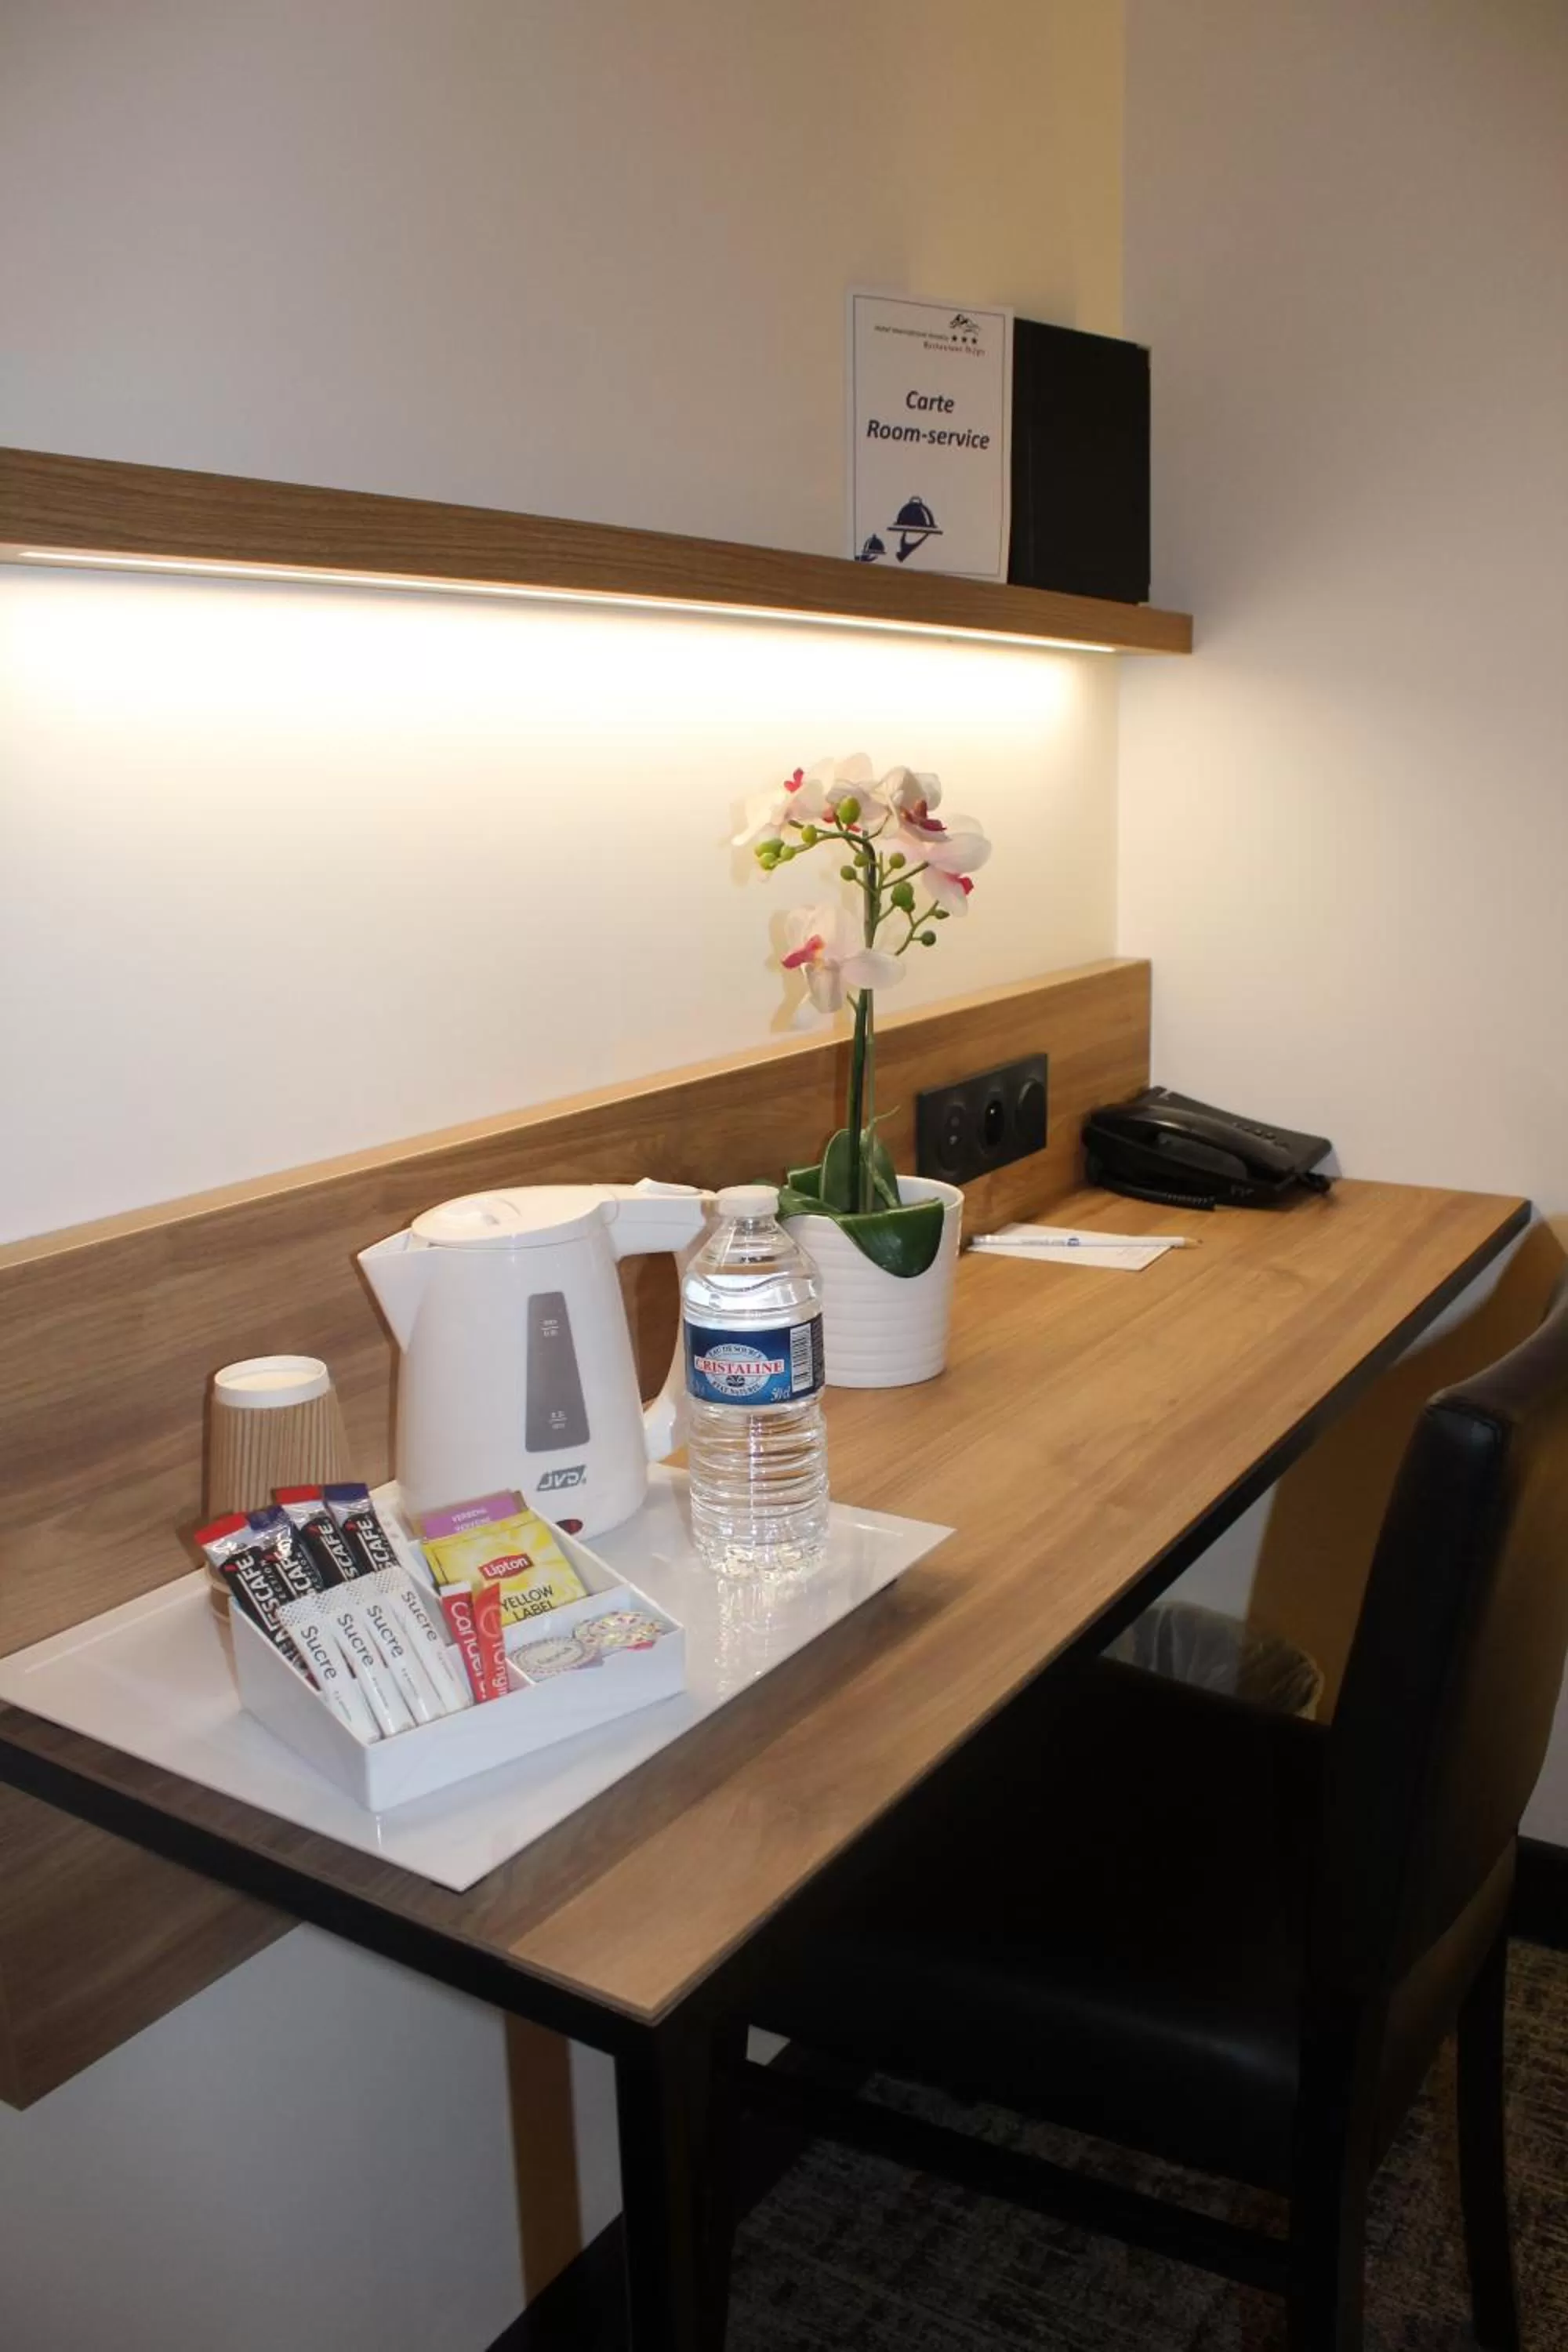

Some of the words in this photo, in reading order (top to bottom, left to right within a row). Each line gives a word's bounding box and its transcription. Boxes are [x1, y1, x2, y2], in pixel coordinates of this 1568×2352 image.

[906, 390, 955, 413] Carte
[867, 419, 990, 449] Room-service
[538, 1471, 581, 1490] JVD
[484, 1556, 528, 1577] Lipton
[502, 1584, 554, 1613] YELLOW
[512, 1602, 554, 1621] LABEL
[401, 1591, 437, 1642] Sucre
[337, 1613, 374, 1667] Sucre
[366, 1605, 404, 1658] Sucre
[301, 1625, 337, 1679] Sucre
